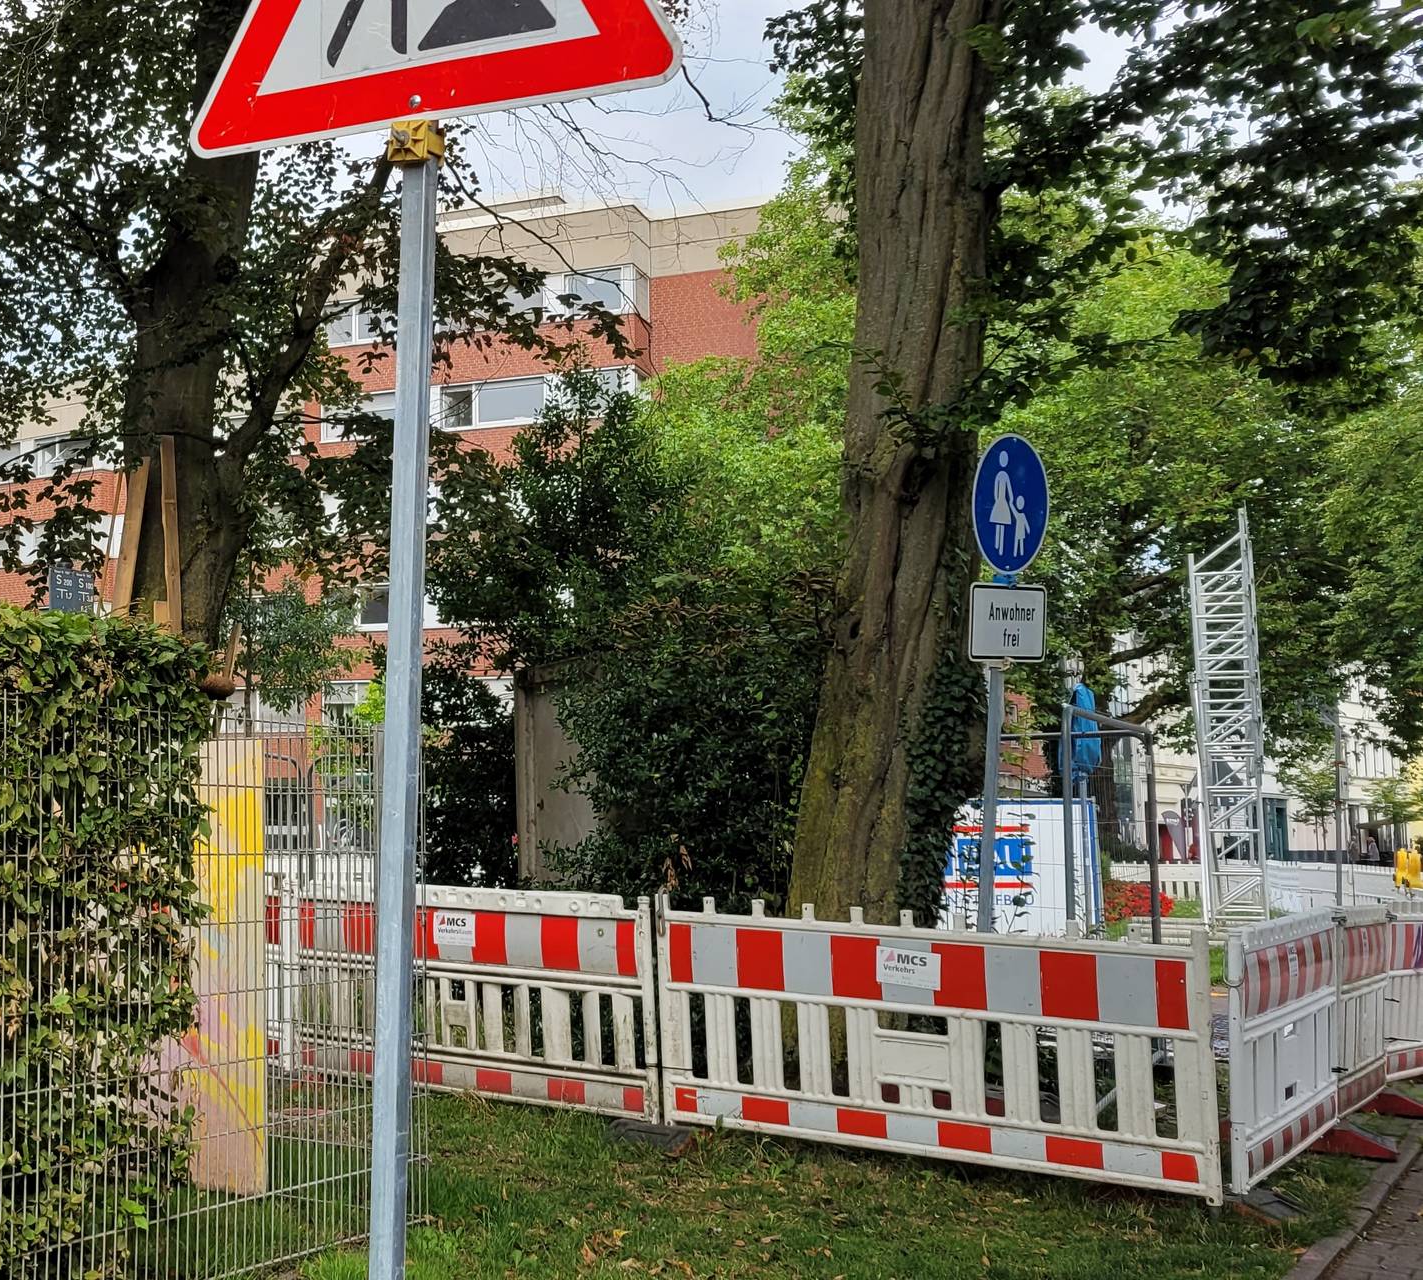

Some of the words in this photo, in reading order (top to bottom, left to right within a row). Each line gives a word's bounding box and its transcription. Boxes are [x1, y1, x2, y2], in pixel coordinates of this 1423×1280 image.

[56, 574, 63, 585] S
[78, 578, 85, 589] S
[988, 601, 1036, 622] Anwohner
[1003, 628, 1020, 647] frei
[446, 917, 467, 927] MCS
[897, 953, 928, 967] MCS
